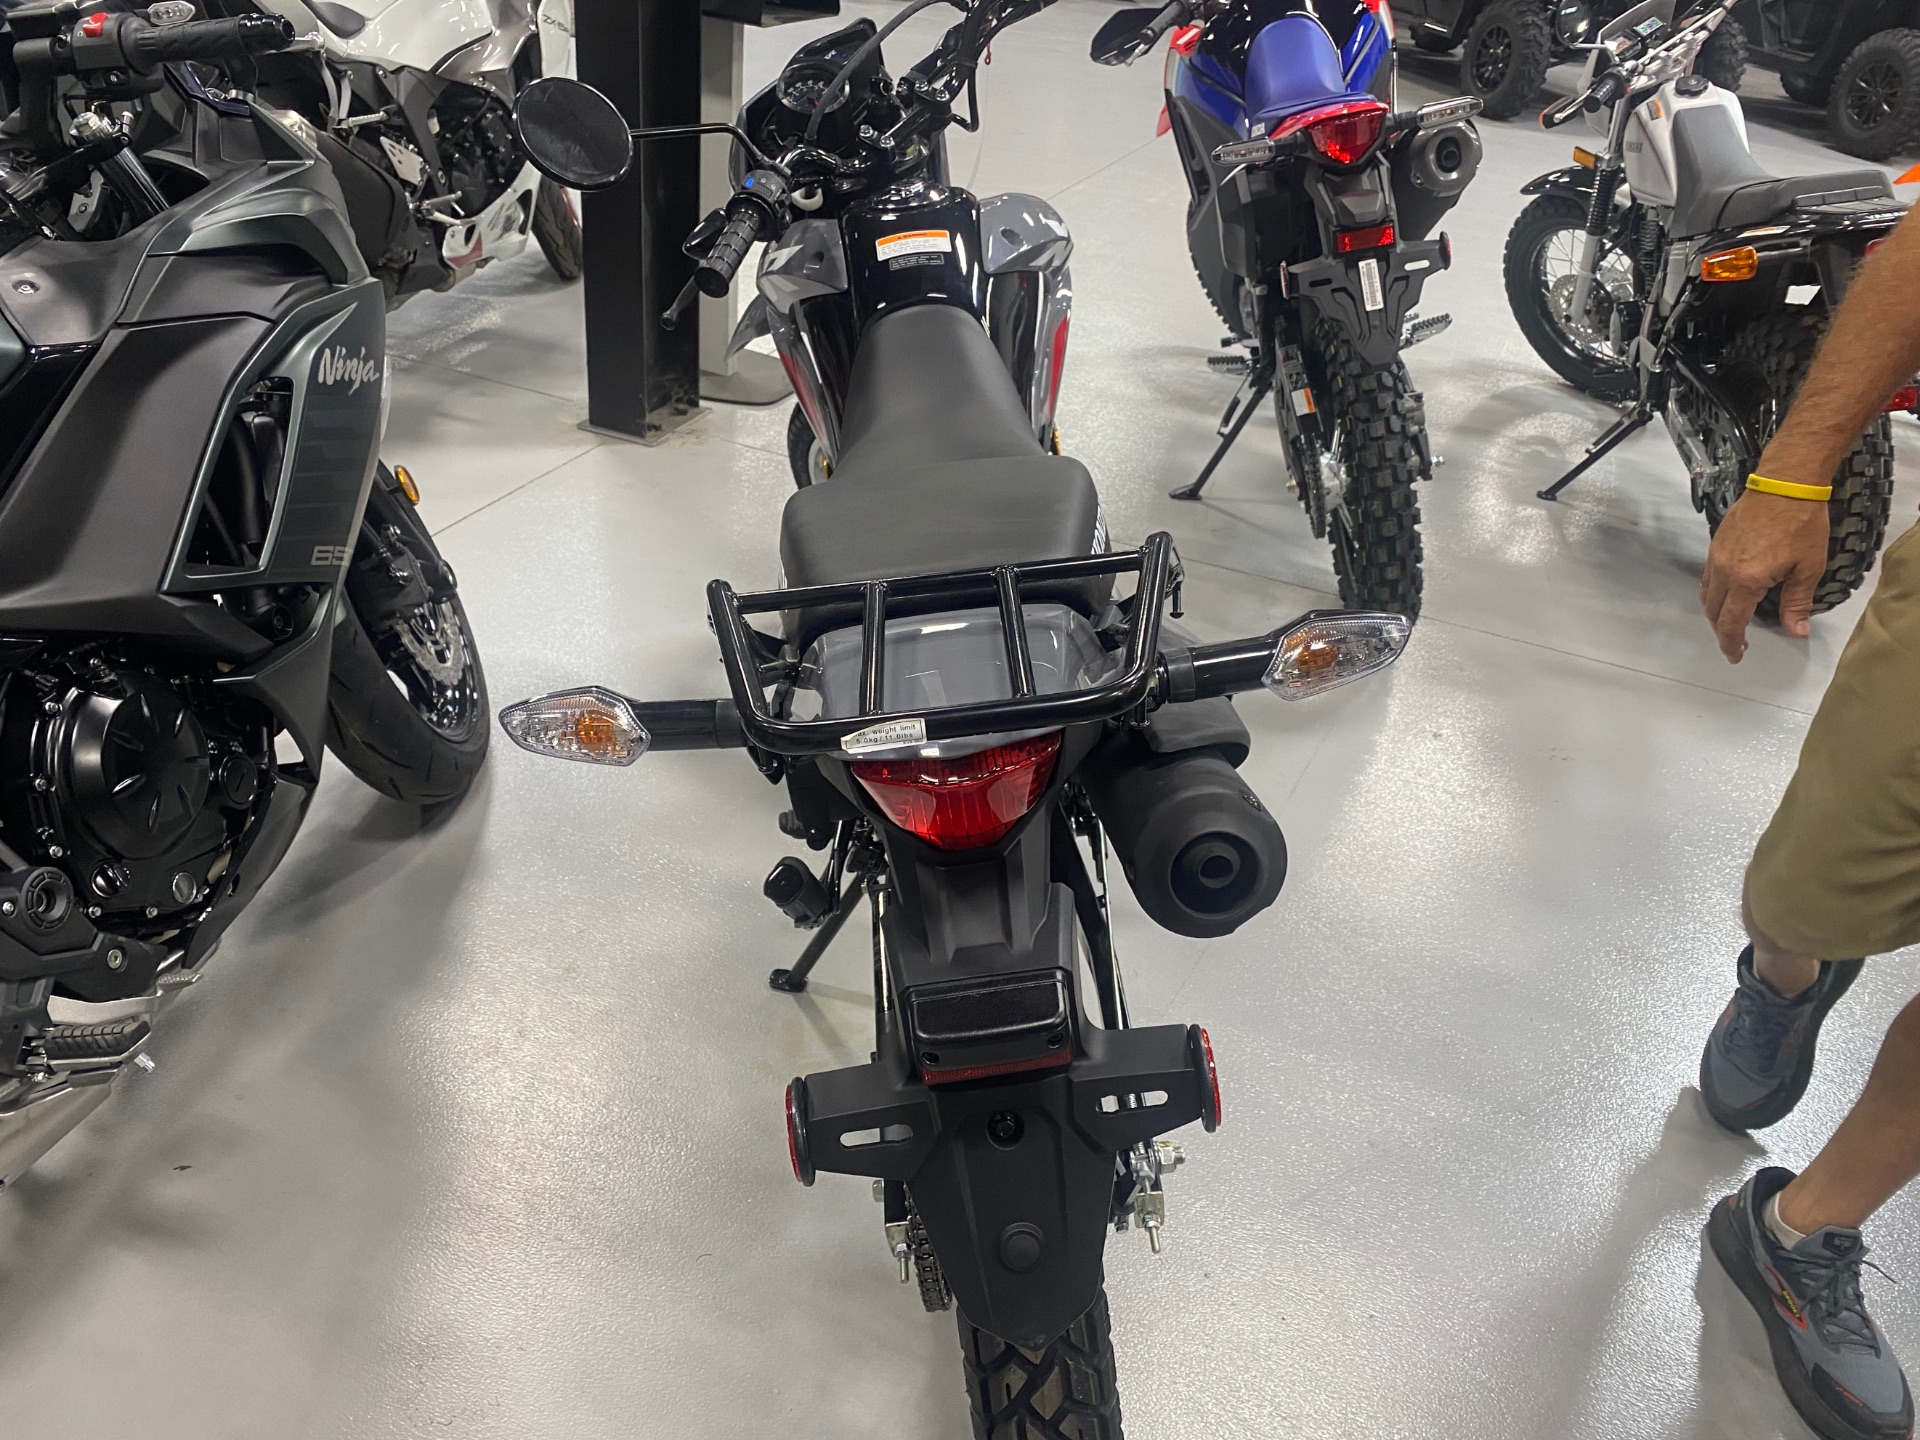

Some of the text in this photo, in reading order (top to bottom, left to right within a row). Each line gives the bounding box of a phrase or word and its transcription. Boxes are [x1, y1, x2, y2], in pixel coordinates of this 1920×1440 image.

[317, 345, 380, 396] Ninja
[872, 726, 897, 736] weight
[900, 723, 916, 731] limit
[1782, 1290, 1800, 1318] BROOKS
